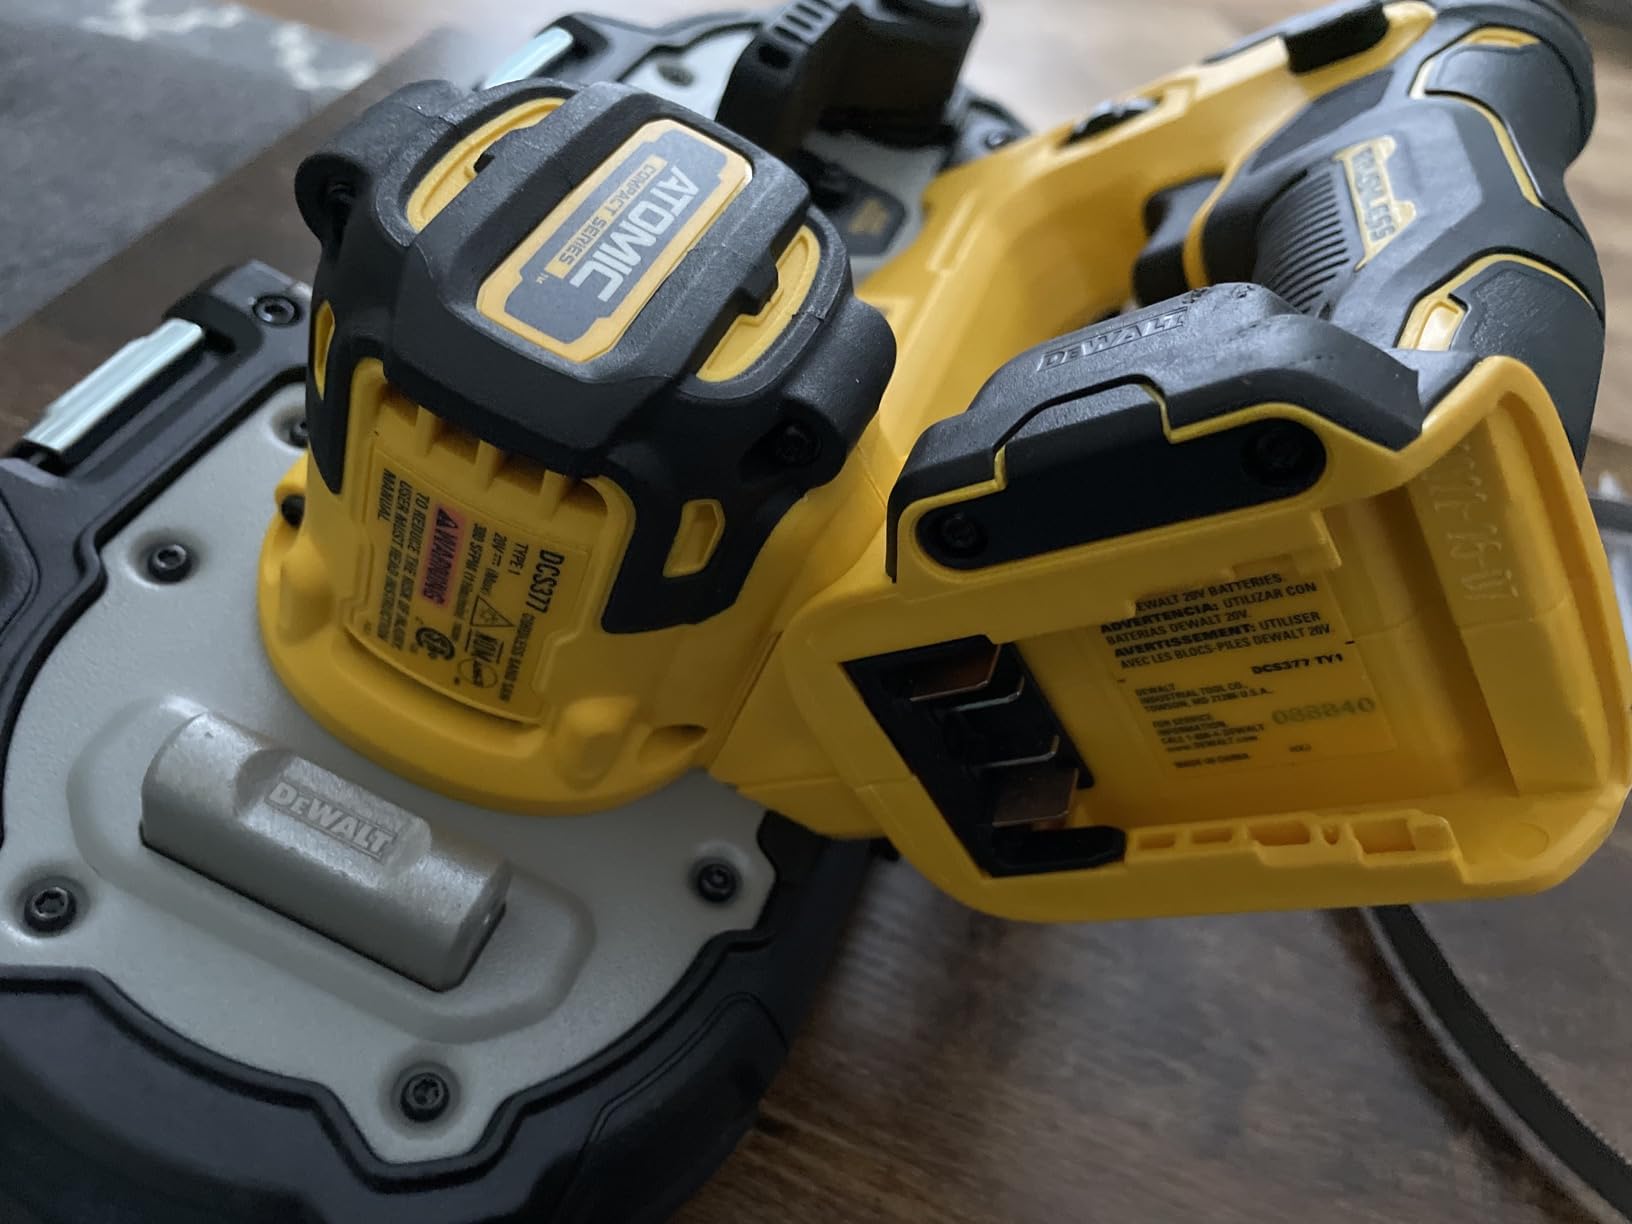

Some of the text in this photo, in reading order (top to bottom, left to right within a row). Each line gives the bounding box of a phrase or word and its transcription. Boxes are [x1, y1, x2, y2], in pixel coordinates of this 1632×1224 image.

[606, 163, 655, 217] COMPACT
[559, 216, 607, 266] SERIES
[569, 165, 699, 302] ATOMIC
[377, 469, 396, 523] MANUAL
[395, 481, 411, 512] USER
[414, 493, 428, 512] TO
[390, 513, 406, 547] MUST
[407, 508, 425, 554] REDUCE
[386, 547, 402, 575] READ
[403, 555, 418, 575] THE
[422, 526, 455, 604] WARNING
[509, 543, 528, 567] TYPE
[526, 549, 563, 612] DCS377
[1102, 581, 1315, 632] ADVERTENCIA: UTILIZAR CON
[1137, 593, 1177, 611] EWALT
[1108, 627, 1164, 644] BATERIAS
[1171, 615, 1219, 632] DEWALT
[1116, 611, 1319, 657] AVERTISSEMENT: UTILISER
[1122, 656, 1149, 669] AVEC
[1153, 651, 1172, 663] LES
[1177, 638, 1248, 659] BLOCS-PILES
[1255, 628, 1302, 644] DEWALT
[1252, 657, 1308, 675] DCS377
